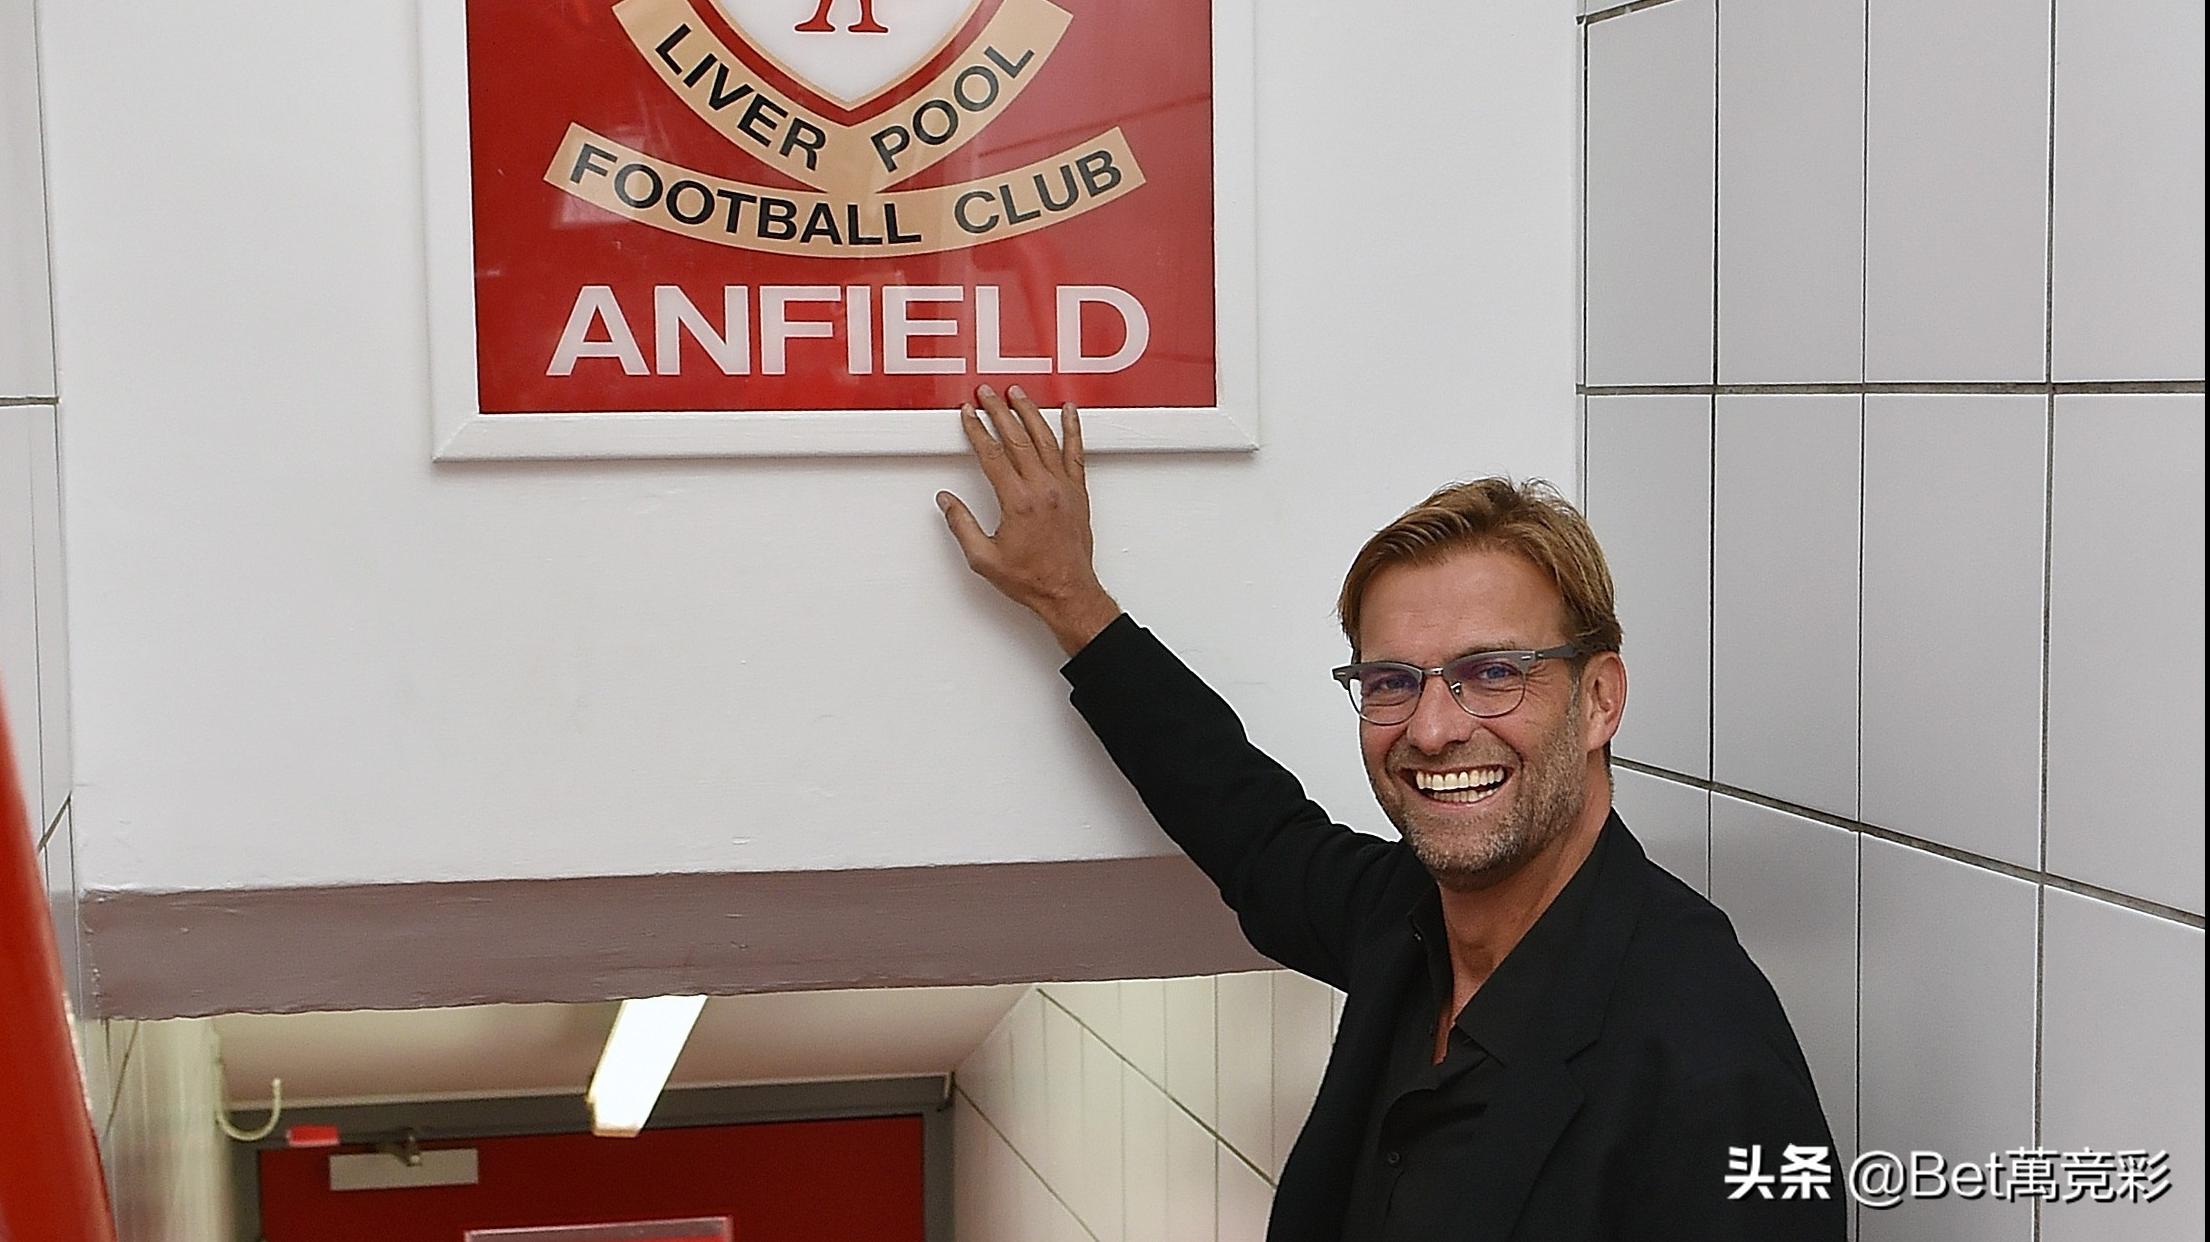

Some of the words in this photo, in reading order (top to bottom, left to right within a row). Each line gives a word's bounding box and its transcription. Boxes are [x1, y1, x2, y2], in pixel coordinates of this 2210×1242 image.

[654, 23, 828, 171] LIVER
[870, 45, 1035, 172] POOL
[569, 143, 922, 246] FOOTBALL
[953, 149, 1123, 235] CLUB
[546, 285, 1151, 376] ANFIELD
